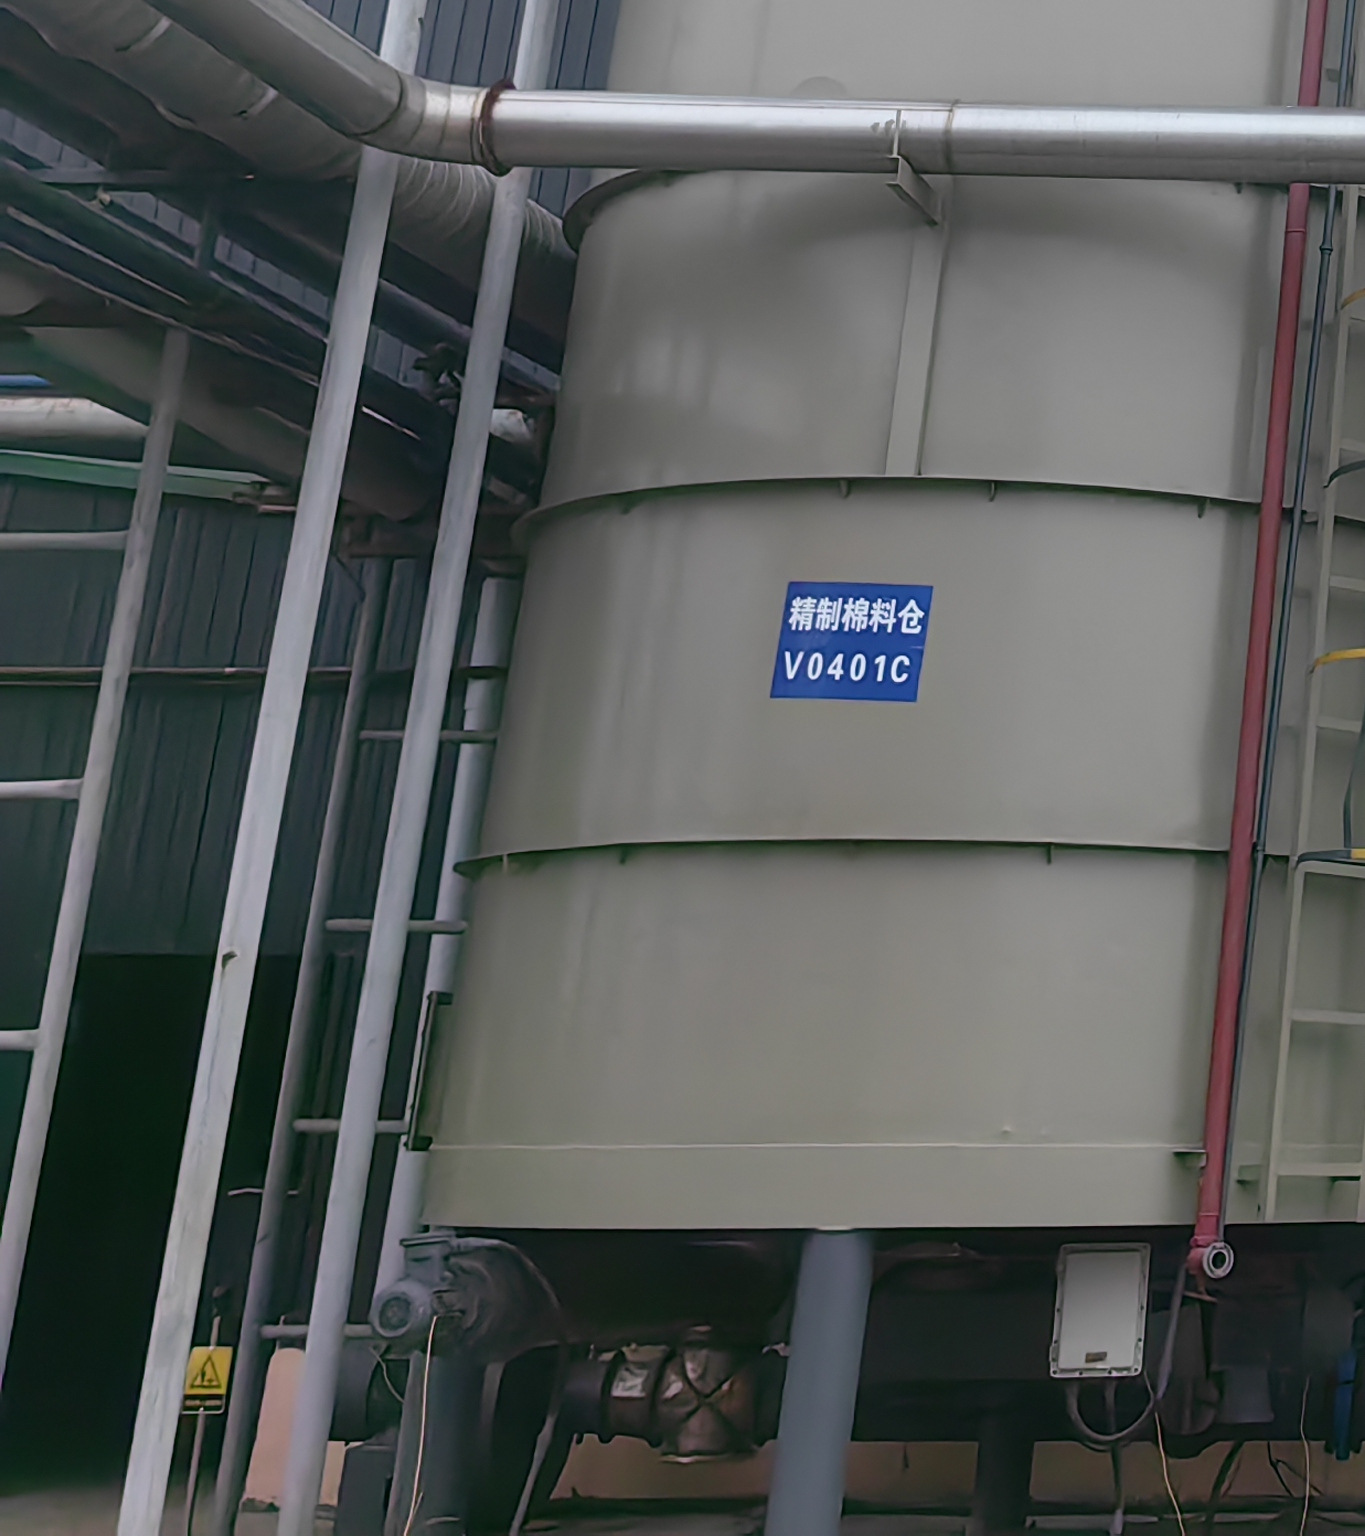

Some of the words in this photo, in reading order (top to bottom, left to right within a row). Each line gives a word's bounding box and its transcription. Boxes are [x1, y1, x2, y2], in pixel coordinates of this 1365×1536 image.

[788, 596, 925, 634] 精制棉料仓
[784, 651, 911, 683] V0401C
